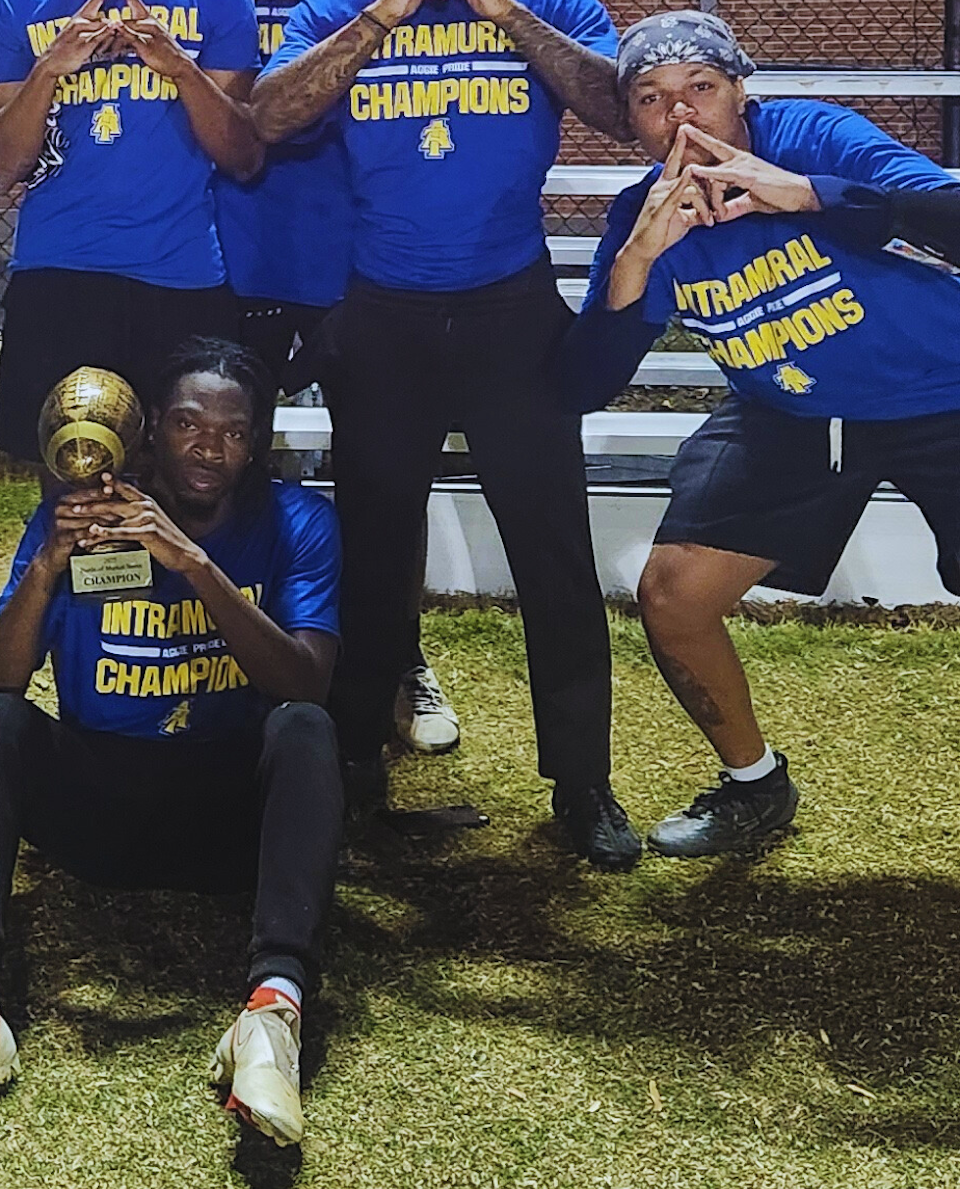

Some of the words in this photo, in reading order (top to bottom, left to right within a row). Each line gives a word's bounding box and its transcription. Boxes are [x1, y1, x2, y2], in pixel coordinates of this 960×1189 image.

[350, 77, 530, 120] CHAMPIONS
[709, 289, 865, 369] HAMPIONS
[84, 572, 141, 586] CHAMPION
